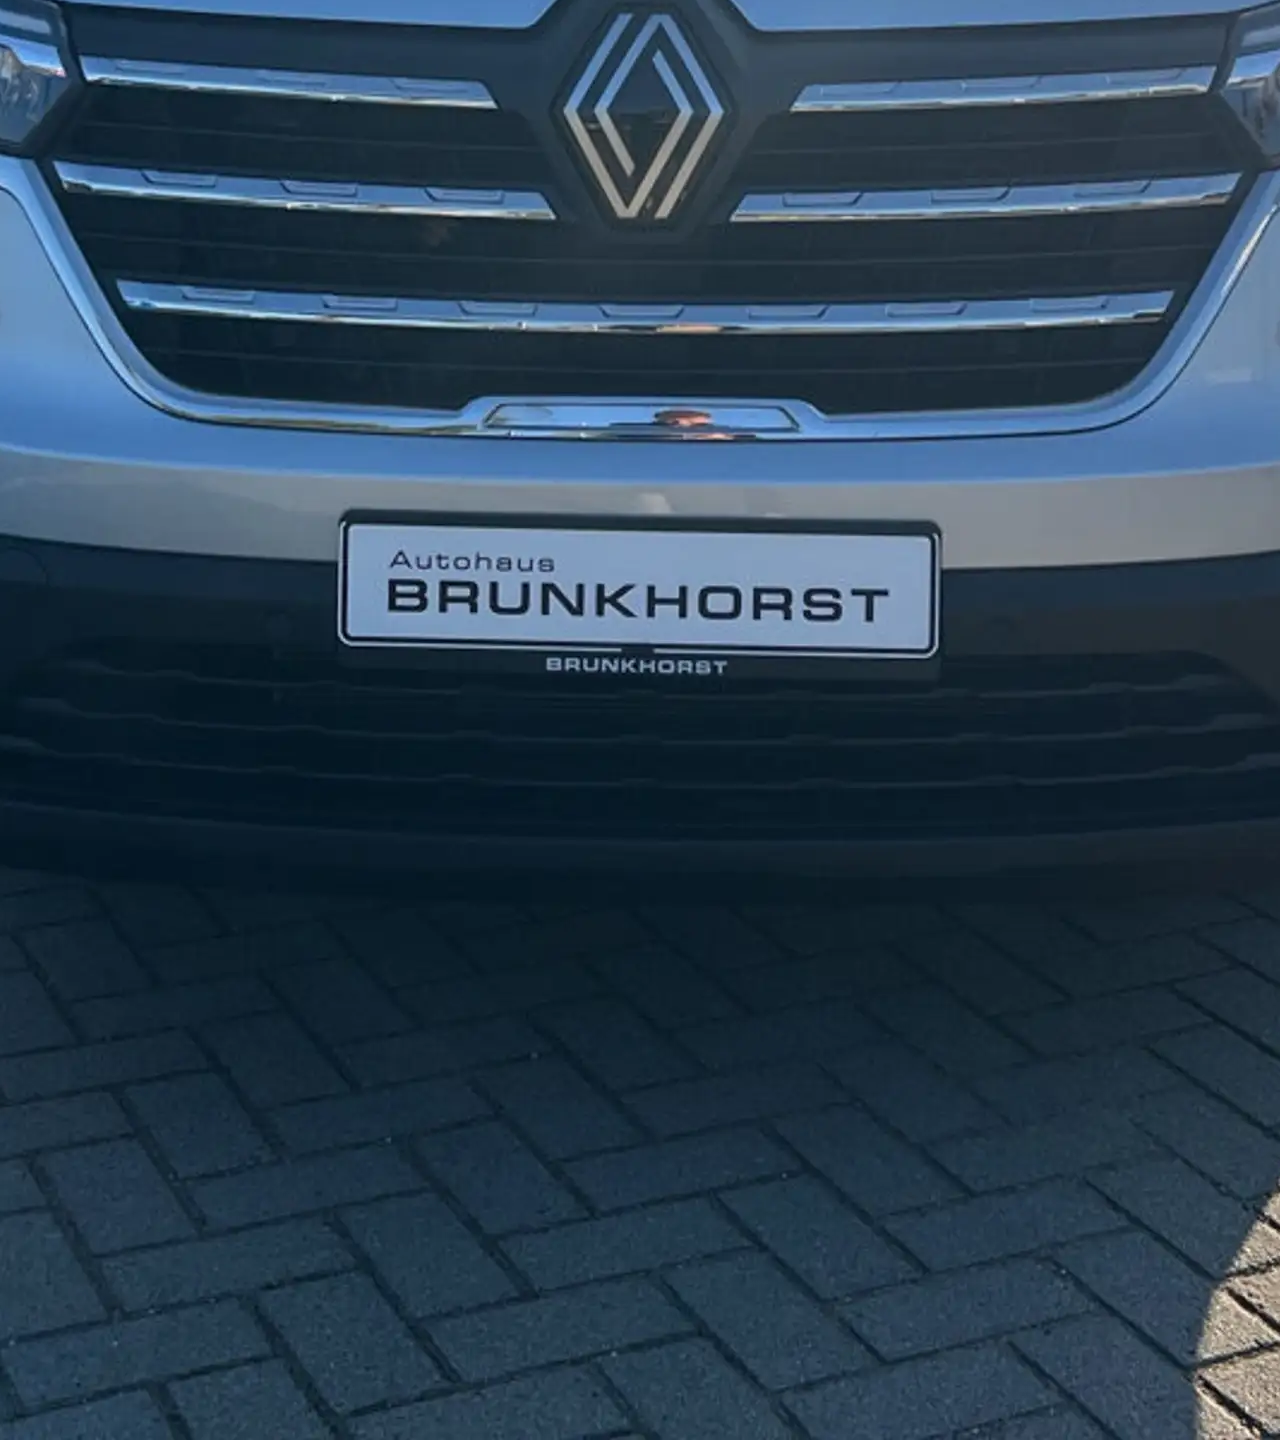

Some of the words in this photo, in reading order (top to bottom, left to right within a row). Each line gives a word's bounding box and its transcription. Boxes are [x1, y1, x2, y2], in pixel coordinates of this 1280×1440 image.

[389, 550, 555, 573] Autohaus
[387, 578, 889, 623] BRUNKHORST
[545, 656, 728, 675] BRUNKHORST
